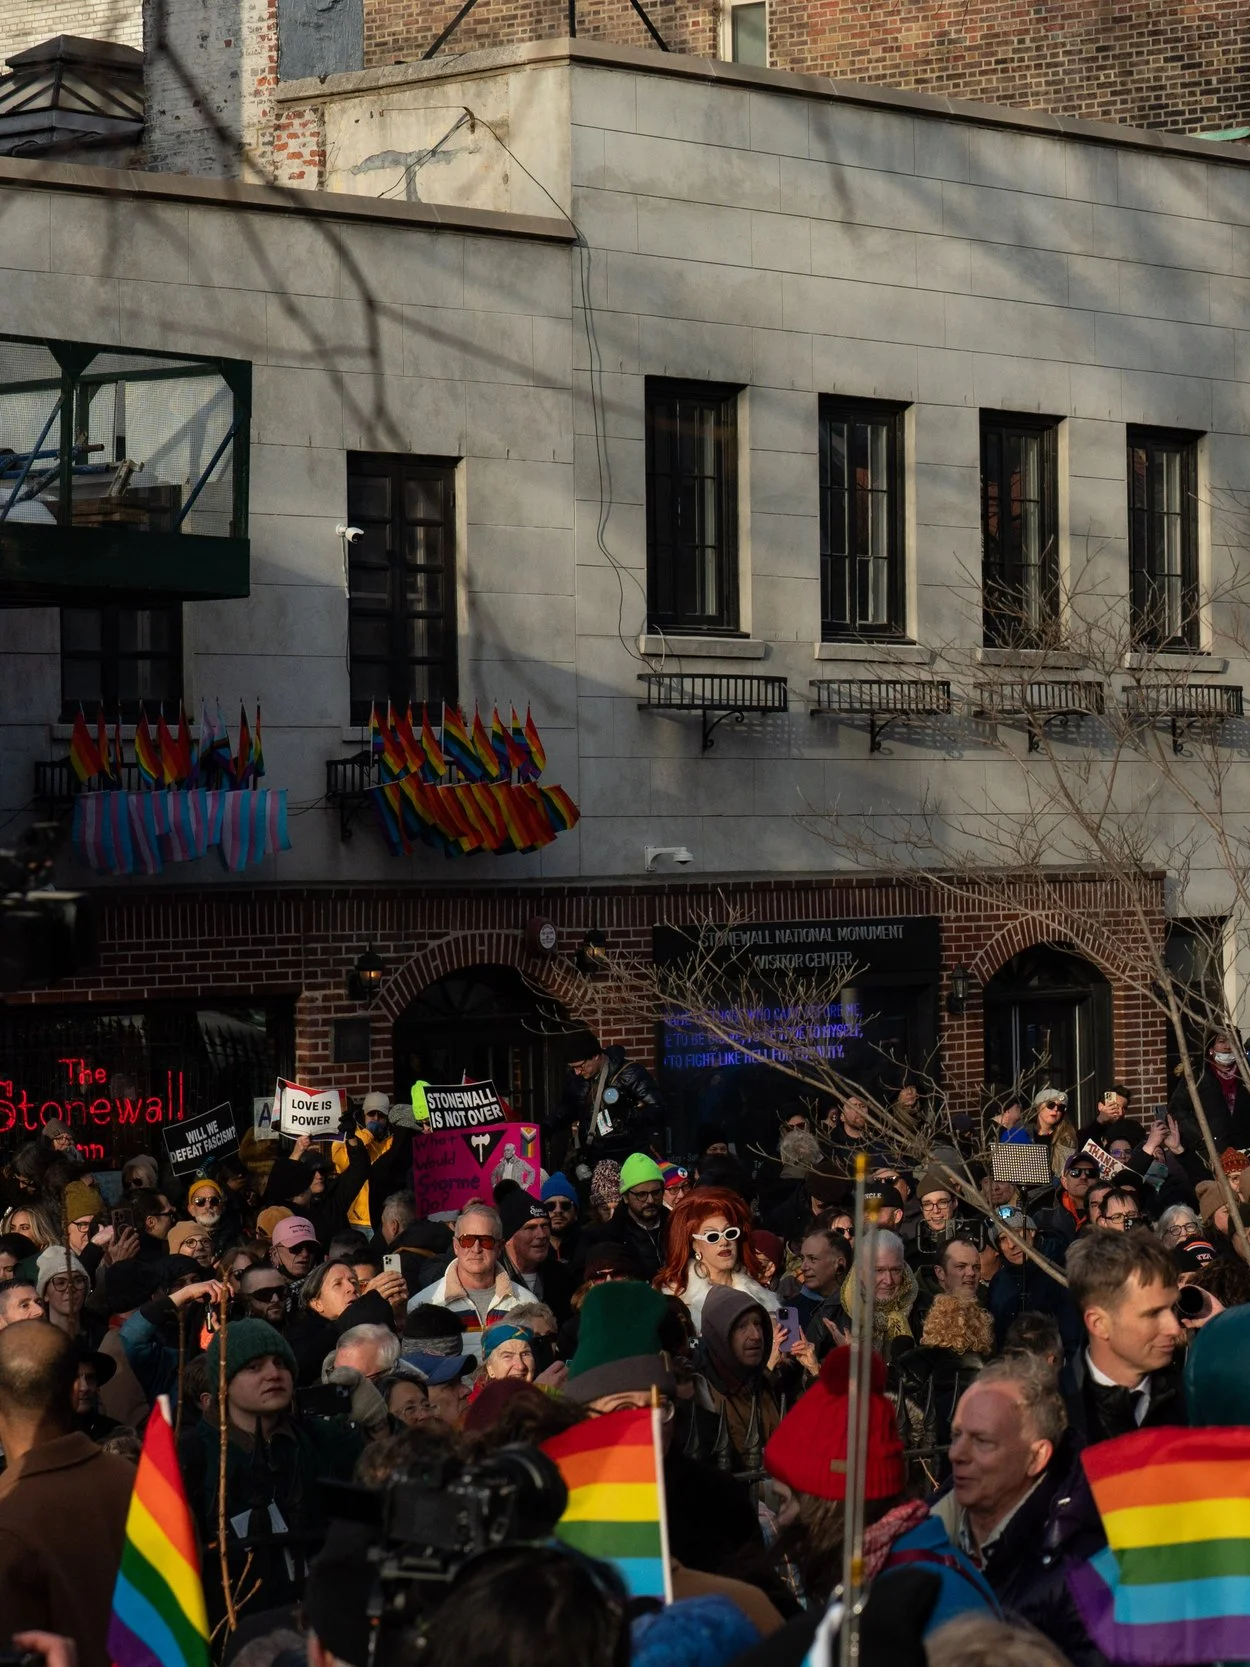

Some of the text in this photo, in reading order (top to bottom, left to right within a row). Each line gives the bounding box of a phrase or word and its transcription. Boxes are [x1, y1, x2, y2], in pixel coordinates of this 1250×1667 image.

[701, 925, 904, 947] STONEWALL NATIONAL MONUMENT
[754, 952, 852, 969] VISITOR CENTER
[686, 1052, 716, 1068] FIGHT
[718, 1049, 740, 1066] LIKE
[58, 1057, 107, 1085] The
[291, 1098, 332, 1111] LOVE IS
[426, 1088, 497, 1110] STONEWALL
[258, 1102, 271, 1128] A
[291, 1115, 330, 1126] POWER
[430, 1104, 503, 1128] IS NOT OVER
[185, 1120, 219, 1144] WILL WE
[414, 1134, 459, 1149] What
[169, 1125, 236, 1164] DEFEAT FASCISM?
[414, 1151, 456, 1170] Would
